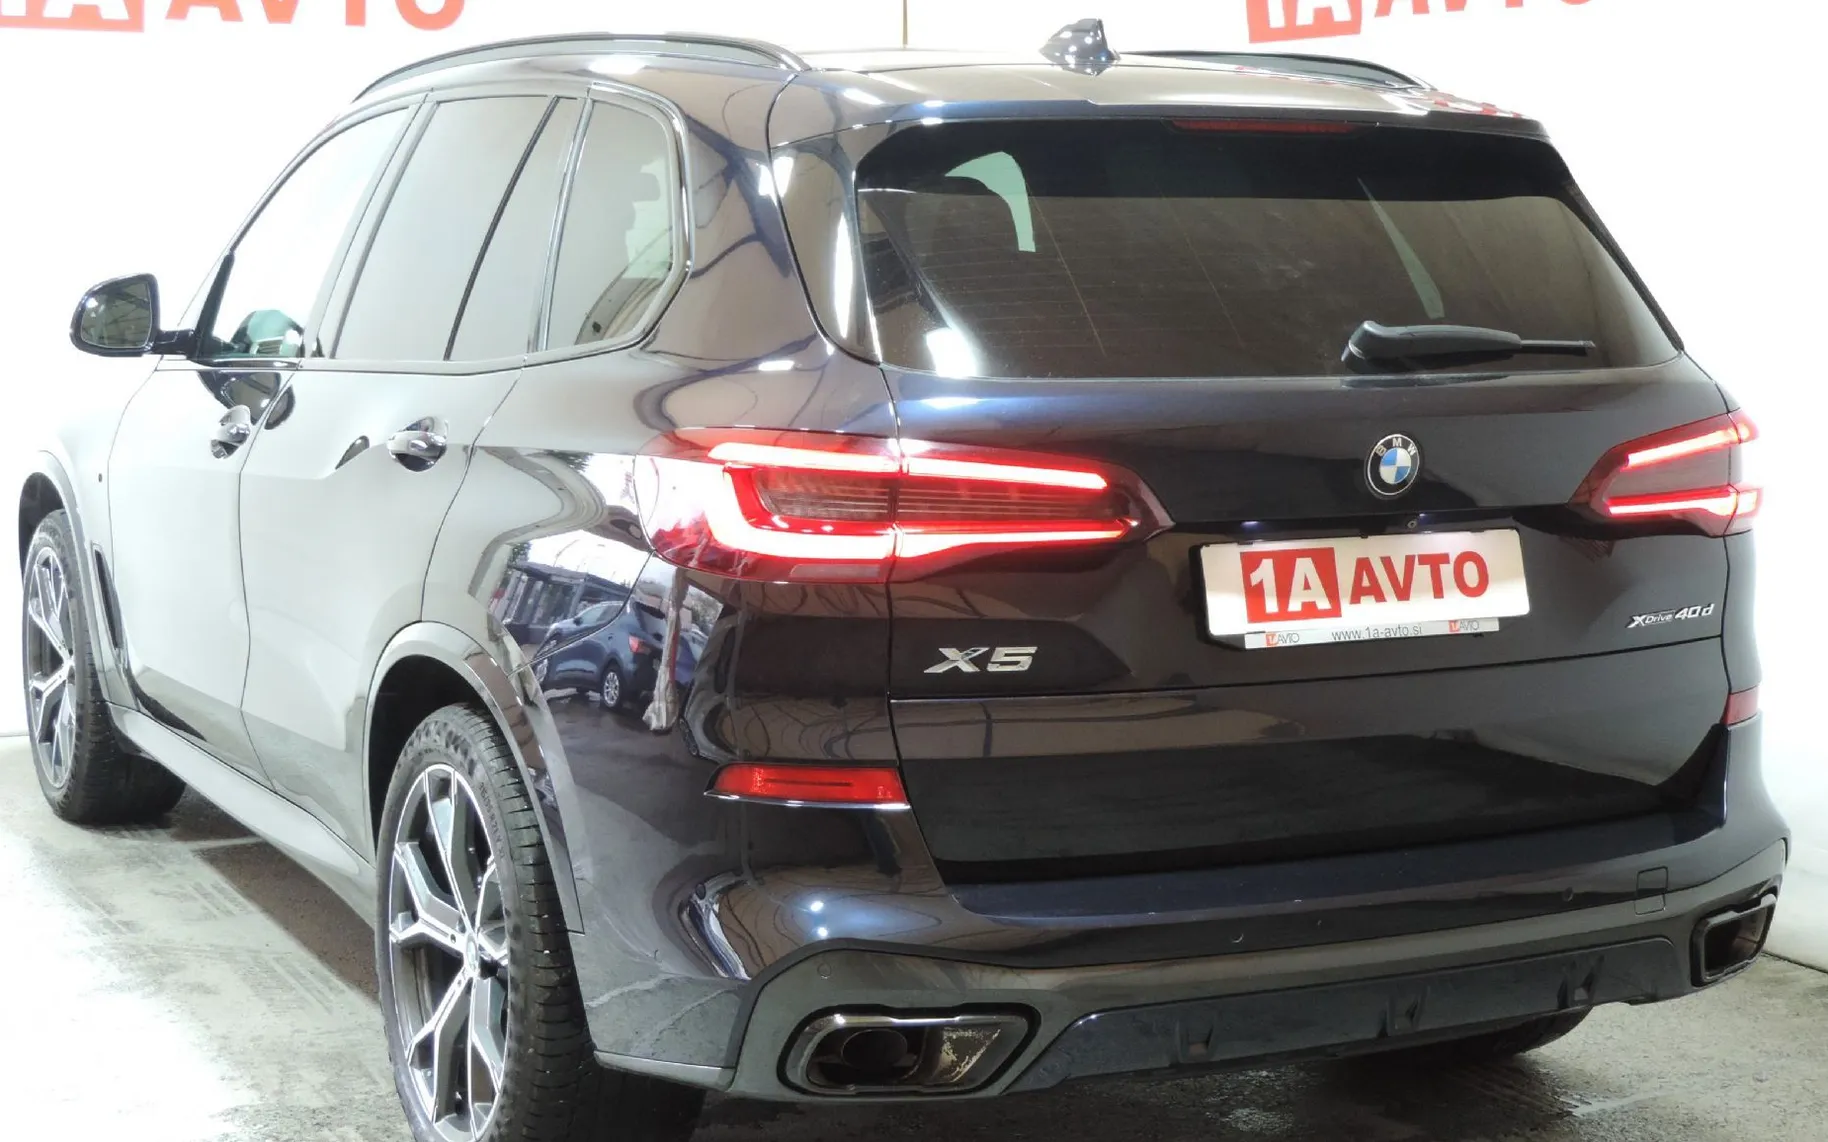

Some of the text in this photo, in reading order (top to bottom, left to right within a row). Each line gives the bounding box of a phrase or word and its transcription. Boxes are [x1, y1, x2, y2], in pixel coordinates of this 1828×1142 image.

[1375, 437, 1417, 456] BMW
[1249, 550, 1489, 615] 1A AVTO
[1331, 623, 1423, 641] www.1a-avto.si
[923, 646, 1038, 673] X5
